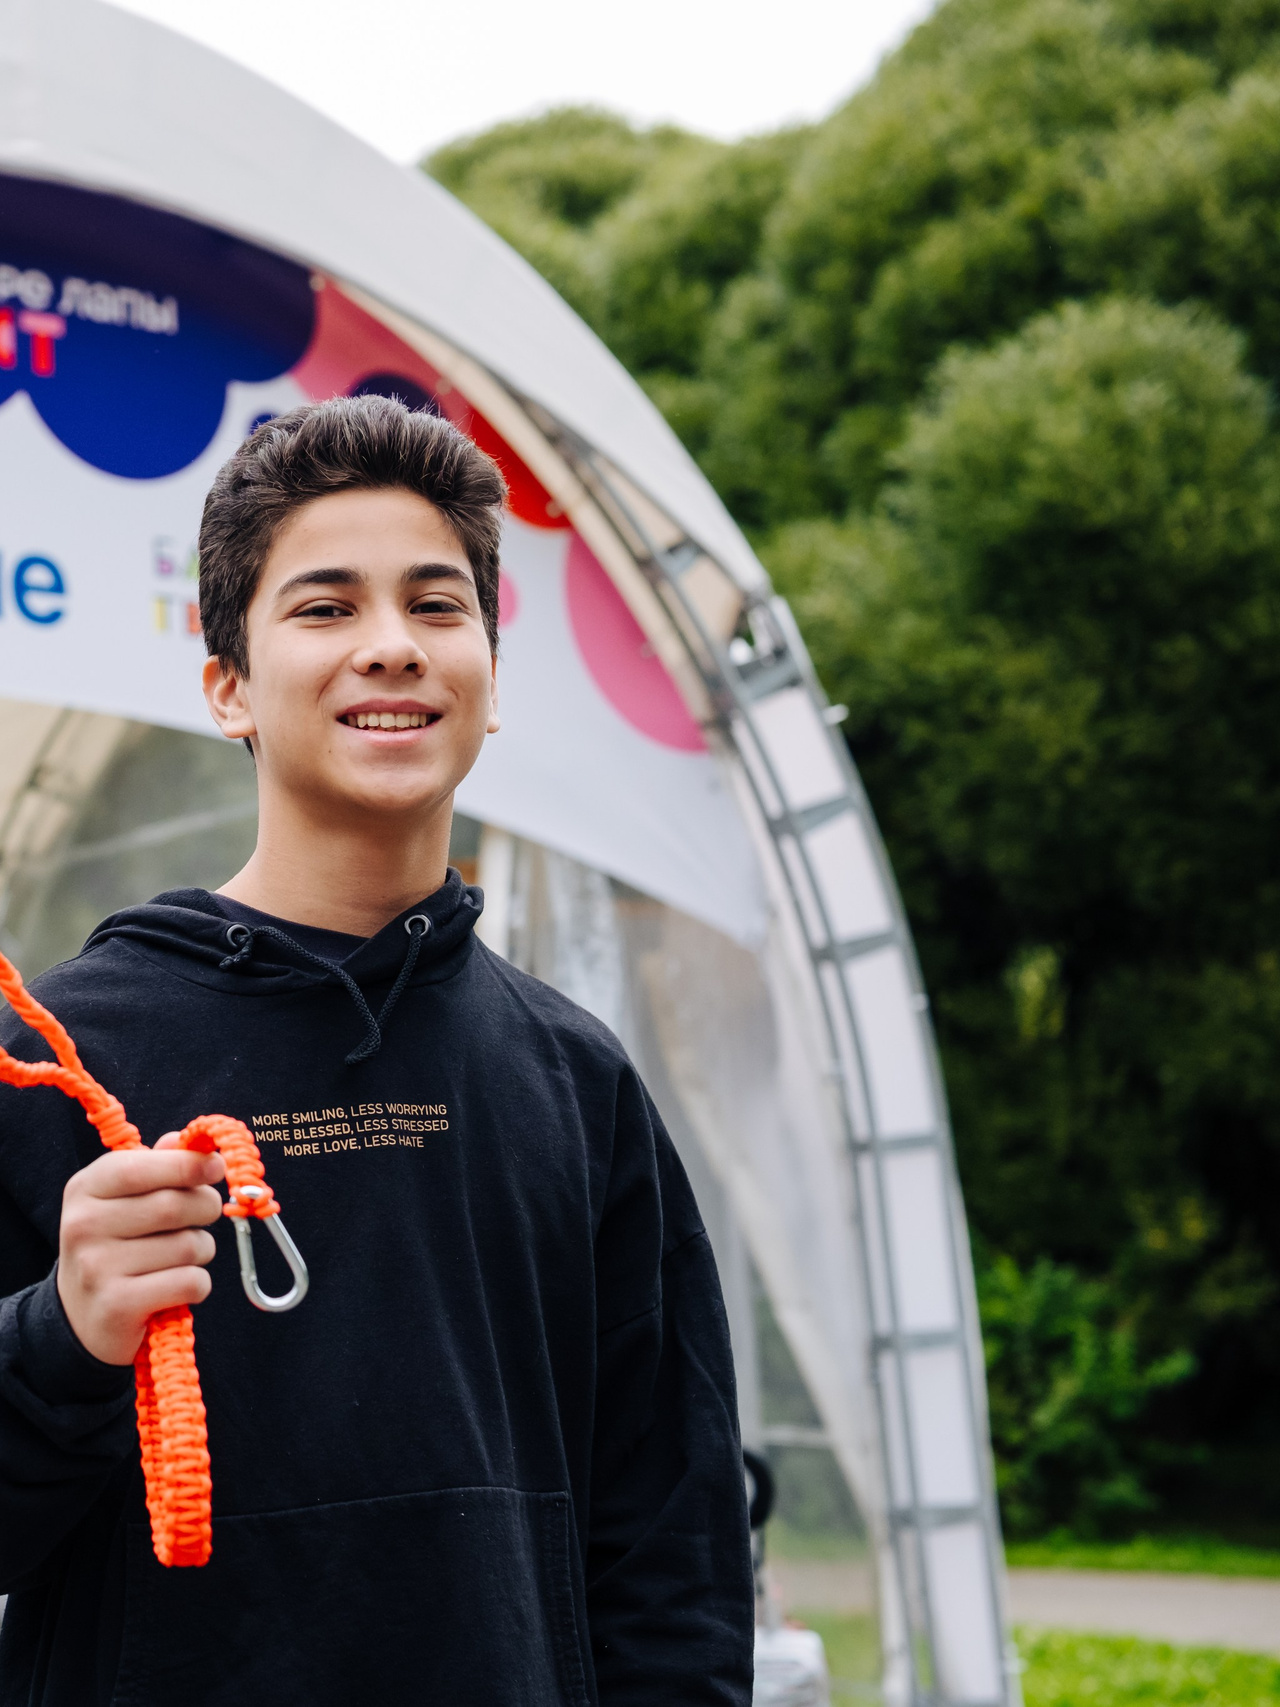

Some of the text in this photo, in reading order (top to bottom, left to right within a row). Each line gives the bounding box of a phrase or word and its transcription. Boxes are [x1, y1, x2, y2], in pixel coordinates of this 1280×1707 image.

[252, 1103, 447, 1126] MORE SMILING, LESS WORRYING
[255, 1118, 449, 1142] MORE BLESSED, LESS STRESSED
[283, 1134, 424, 1157] MORE LOVE, LESS HATE
